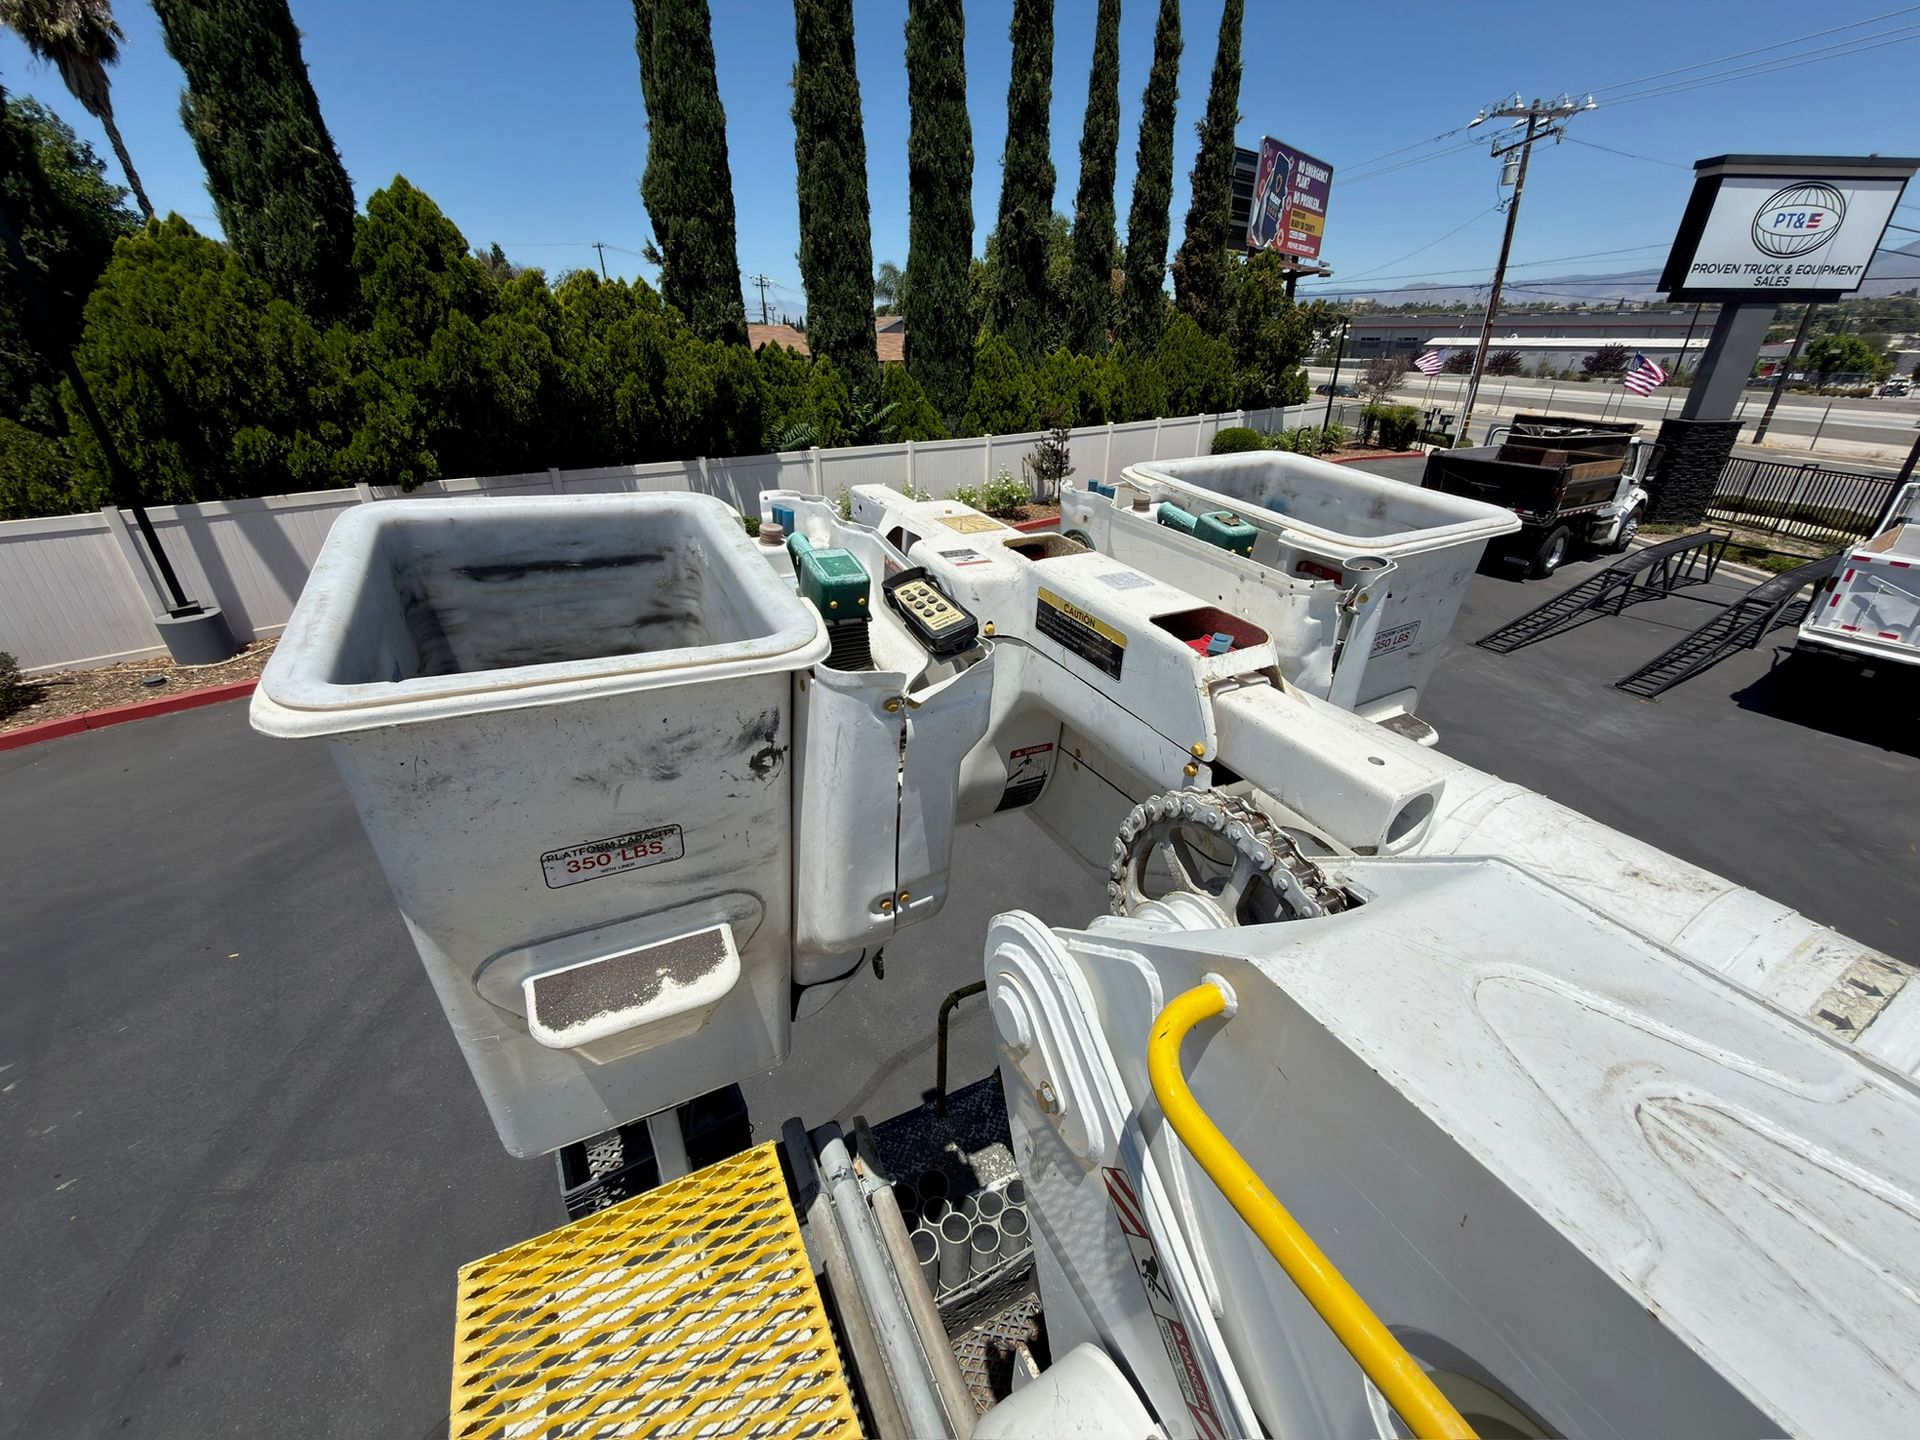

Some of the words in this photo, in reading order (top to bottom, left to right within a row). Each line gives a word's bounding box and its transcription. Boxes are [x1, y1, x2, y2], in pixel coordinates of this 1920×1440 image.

[1298, 160, 1305, 174] NO
[1305, 162, 1329, 184] EMERGENCY
[1295, 174, 1310, 190] PLAN?
[1292, 192, 1300, 206] NO
[1773, 212, 1824, 229] PT&E
[1690, 264, 1740, 274] PROVEN
[1743, 264, 1780, 275] TRUCK
[1785, 264, 1792, 275] &
[1795, 264, 1864, 275] EQUIPMENT
[1754, 276, 1790, 287] SALES
[1063, 603, 1096, 628] CAUTION
[1374, 640, 1390, 651] 350
[1393, 632, 1410, 644] LBS
[546, 840, 616, 863] PLATFORM
[617, 828, 677, 848] CAPACITY
[566, 853, 612, 874] 350
[621, 841, 664, 862] LBS
[618, 862, 636, 870] LINER
[1180, 1344, 1210, 1411] DANGER
